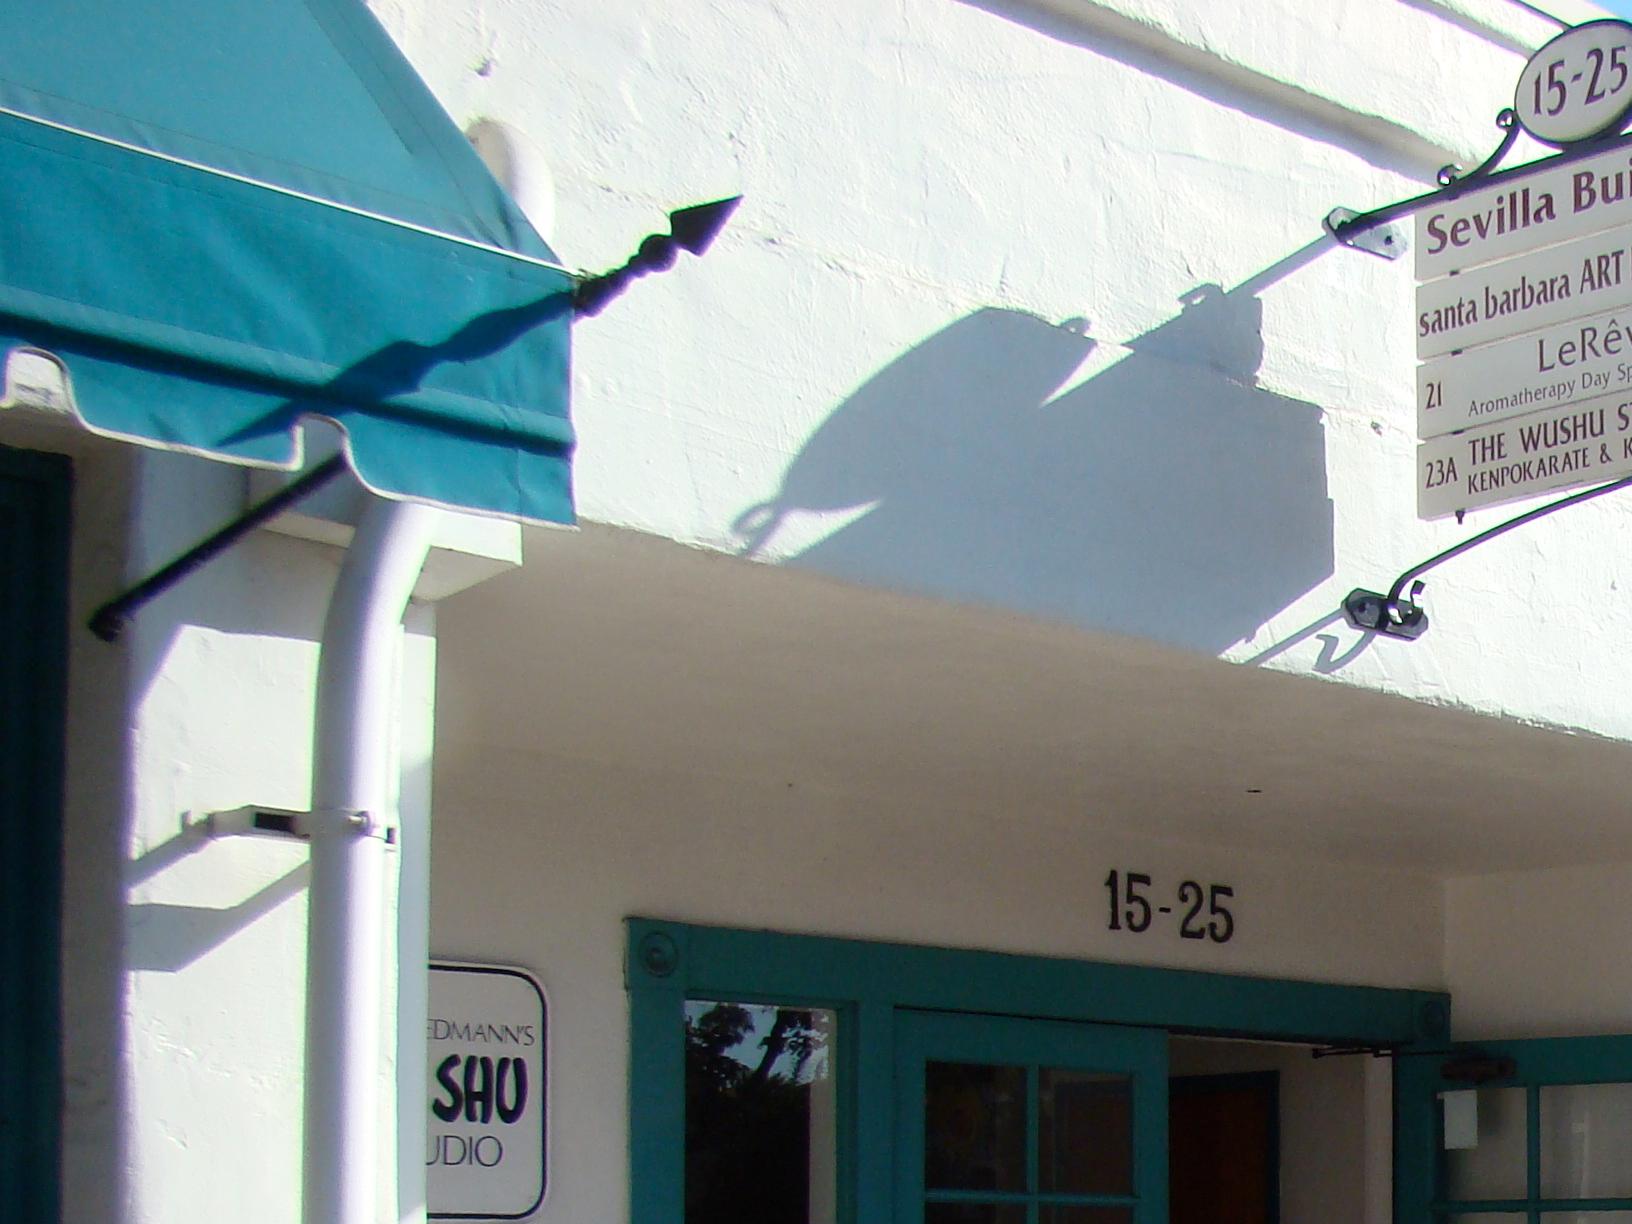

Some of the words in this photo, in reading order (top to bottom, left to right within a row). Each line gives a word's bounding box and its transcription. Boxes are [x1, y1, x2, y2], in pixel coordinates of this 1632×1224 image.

[1532, 45, 1629, 117] 15-25
[1427, 187, 1556, 255] Sevilla
[1419, 296, 1478, 337] santa
[1484, 274, 1571, 320] barbara
[1580, 250, 1624, 293] ART
[1425, 381, 1442, 409] 21
[1468, 379, 1576, 417] Aromatherapy
[1582, 363, 1611, 389] Day
[1468, 433, 1508, 465] THE
[1519, 409, 1605, 453] WUSHU
[1425, 457, 1458, 489] 23A
[1467, 447, 1590, 495] KENPOKARATE
[1600, 443, 1613, 463] &
[1104, 869, 1234, 943] 15-25
